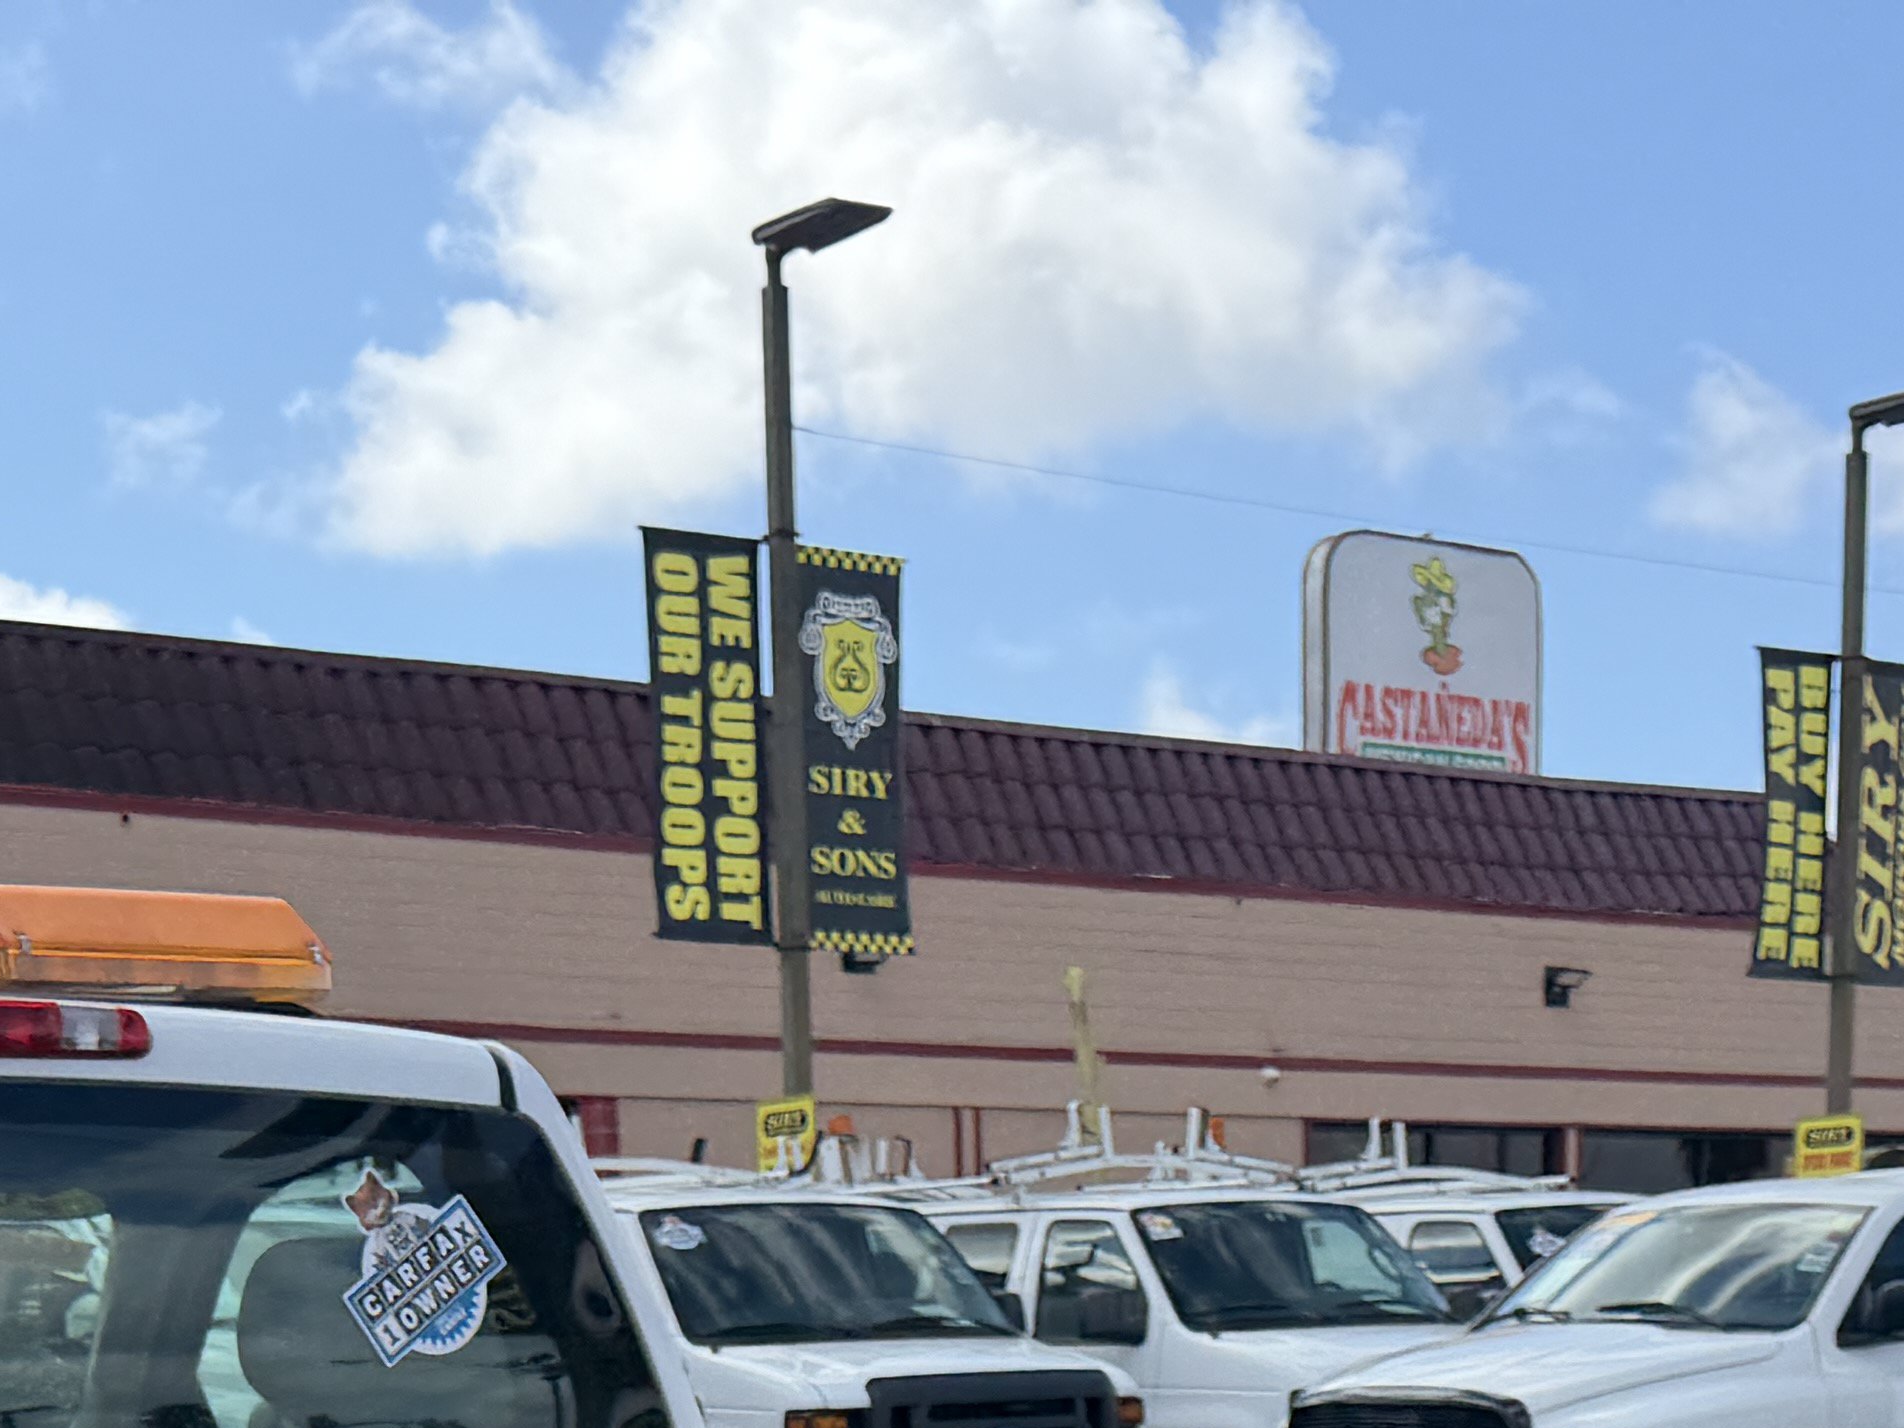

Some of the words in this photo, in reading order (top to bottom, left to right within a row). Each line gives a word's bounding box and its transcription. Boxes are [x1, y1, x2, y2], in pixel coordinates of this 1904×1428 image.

[652, 551, 703, 676] OUR
[705, 554, 752, 650] WE
[807, 764, 893, 800] SIRY
[1765, 666, 1796, 787] PAY
[1798, 665, 1828, 798] BUY
[659, 688, 710, 922] TROOPS
[707, 660, 763, 931] SUPPORT
[837, 808, 866, 835] &
[1853, 672, 1899, 970] SIRY
[810, 846, 897, 880] SONS
[1756, 799, 1795, 962] HERE
[1789, 810, 1824, 969] HERE
[362, 1220, 476, 1317] CARFAX
[382, 1324, 401, 1347] 1
[400, 1243, 491, 1330] OWNER
